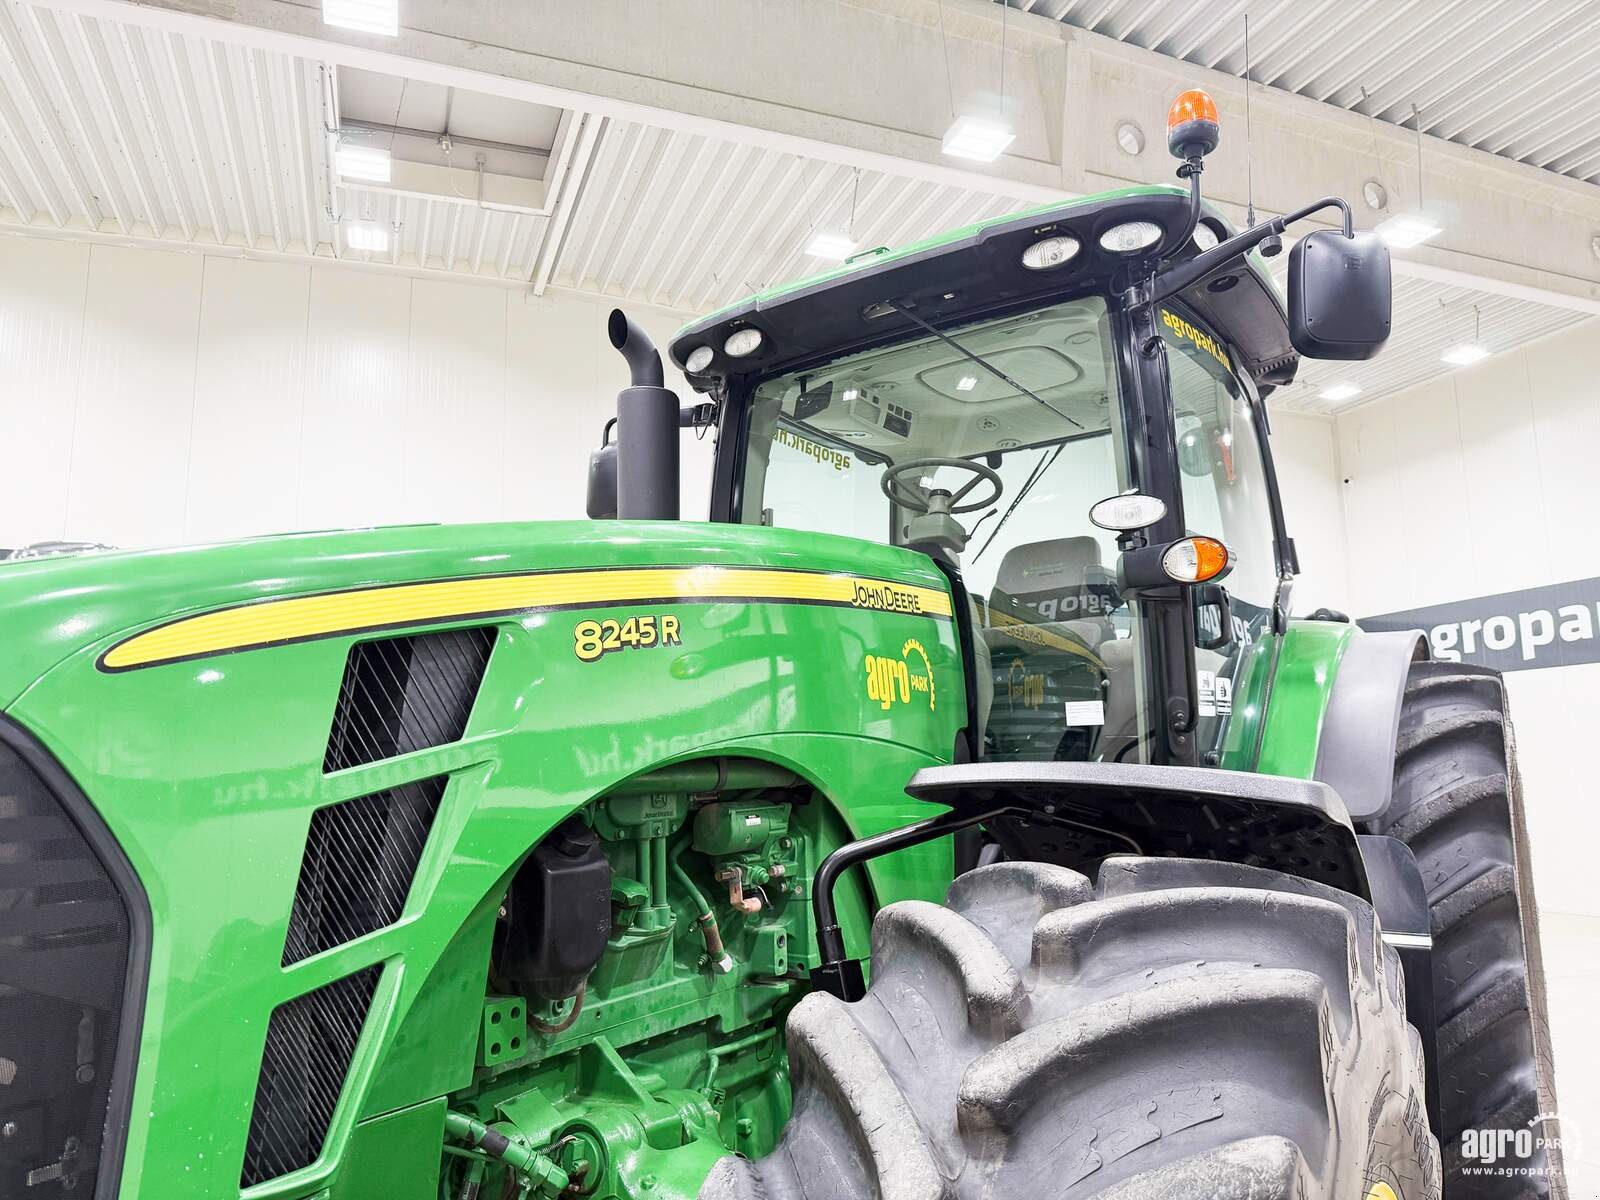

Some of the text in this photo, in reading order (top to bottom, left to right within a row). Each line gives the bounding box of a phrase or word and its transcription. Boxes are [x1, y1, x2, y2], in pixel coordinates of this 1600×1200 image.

[852, 581, 921, 611] JOHN DEERE
[574, 615, 682, 662] 8245 R
[1430, 601, 1600, 664] gropa
[865, 654, 928, 710] agro PARK
